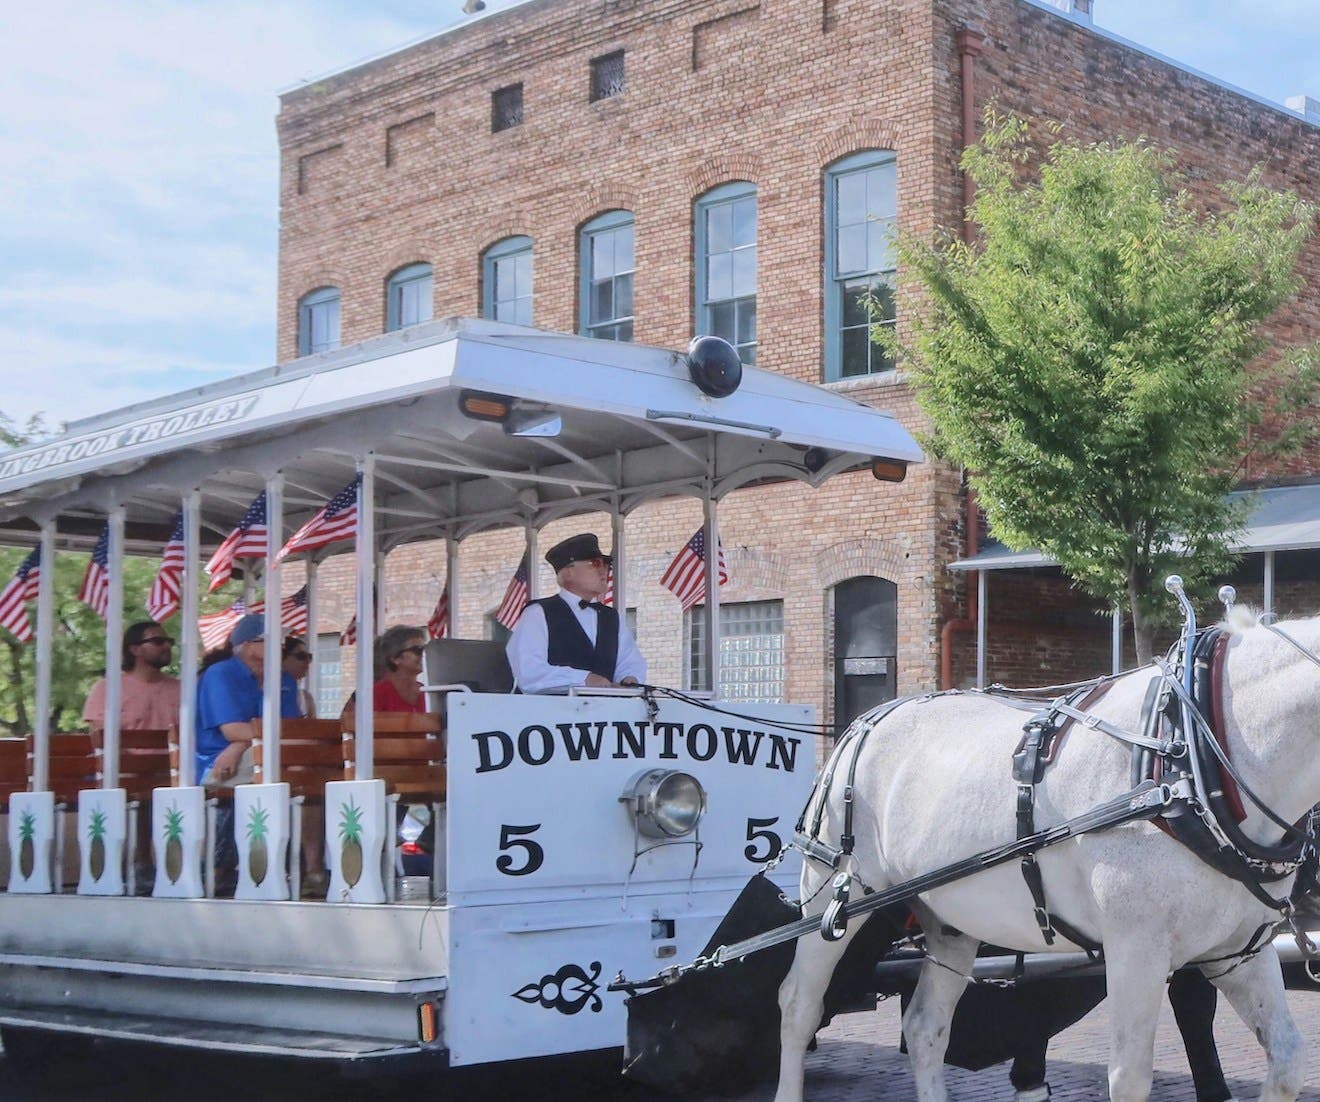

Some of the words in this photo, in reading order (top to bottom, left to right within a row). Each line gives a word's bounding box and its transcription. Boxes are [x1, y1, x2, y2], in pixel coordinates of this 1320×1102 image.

[125, 394, 260, 446] TROLLEY
[471, 721, 802, 774] DOWNTOWN
[495, 823, 544, 877] 5
[743, 816, 783, 864] 5
